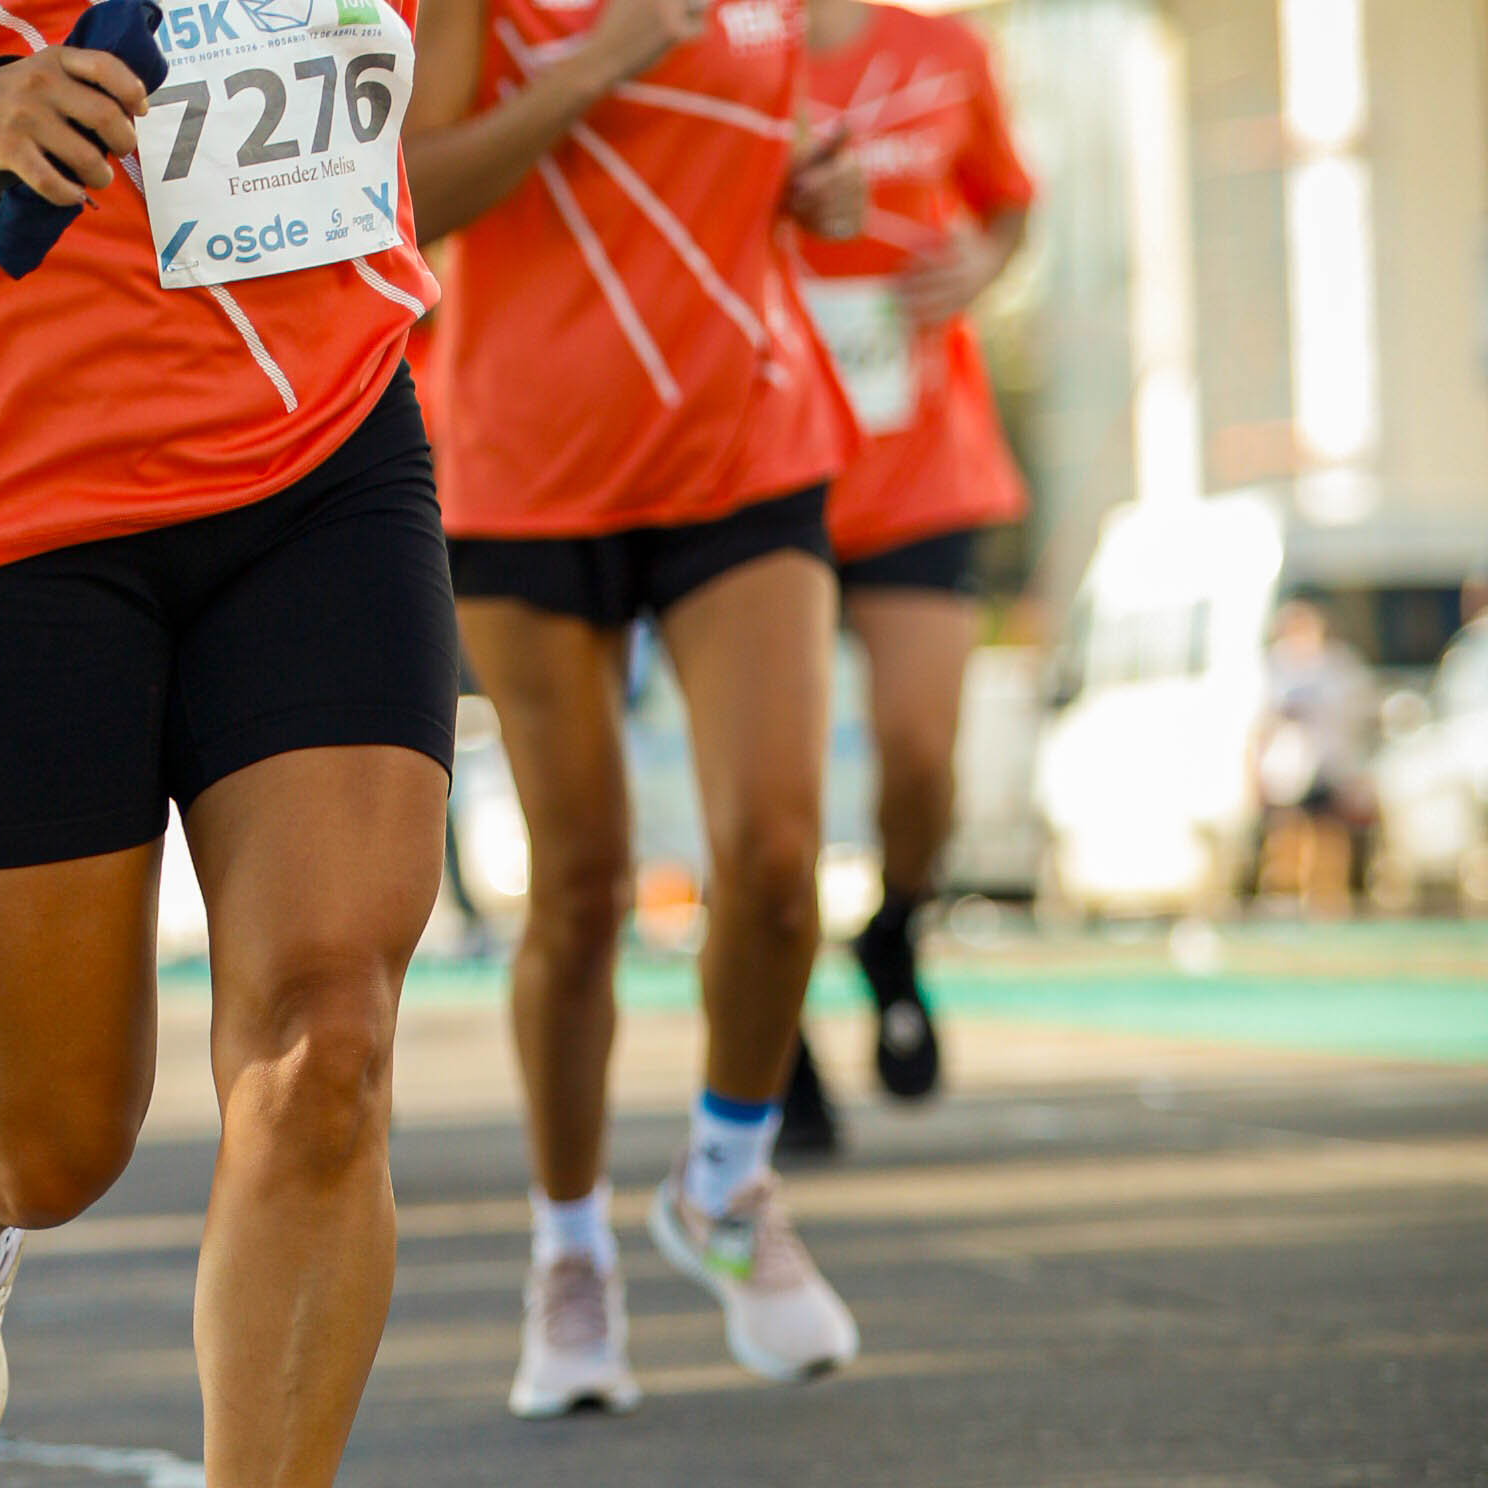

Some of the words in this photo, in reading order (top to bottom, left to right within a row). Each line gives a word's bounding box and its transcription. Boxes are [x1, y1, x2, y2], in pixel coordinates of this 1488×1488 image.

[157, 0, 240, 53] 15K
[199, 47, 232, 61] NORTE
[148, 53, 396, 183] 7276
[228, 165, 319, 196] Fernandez
[320, 155, 356, 179] Melisa
[206, 213, 309, 263] osde
